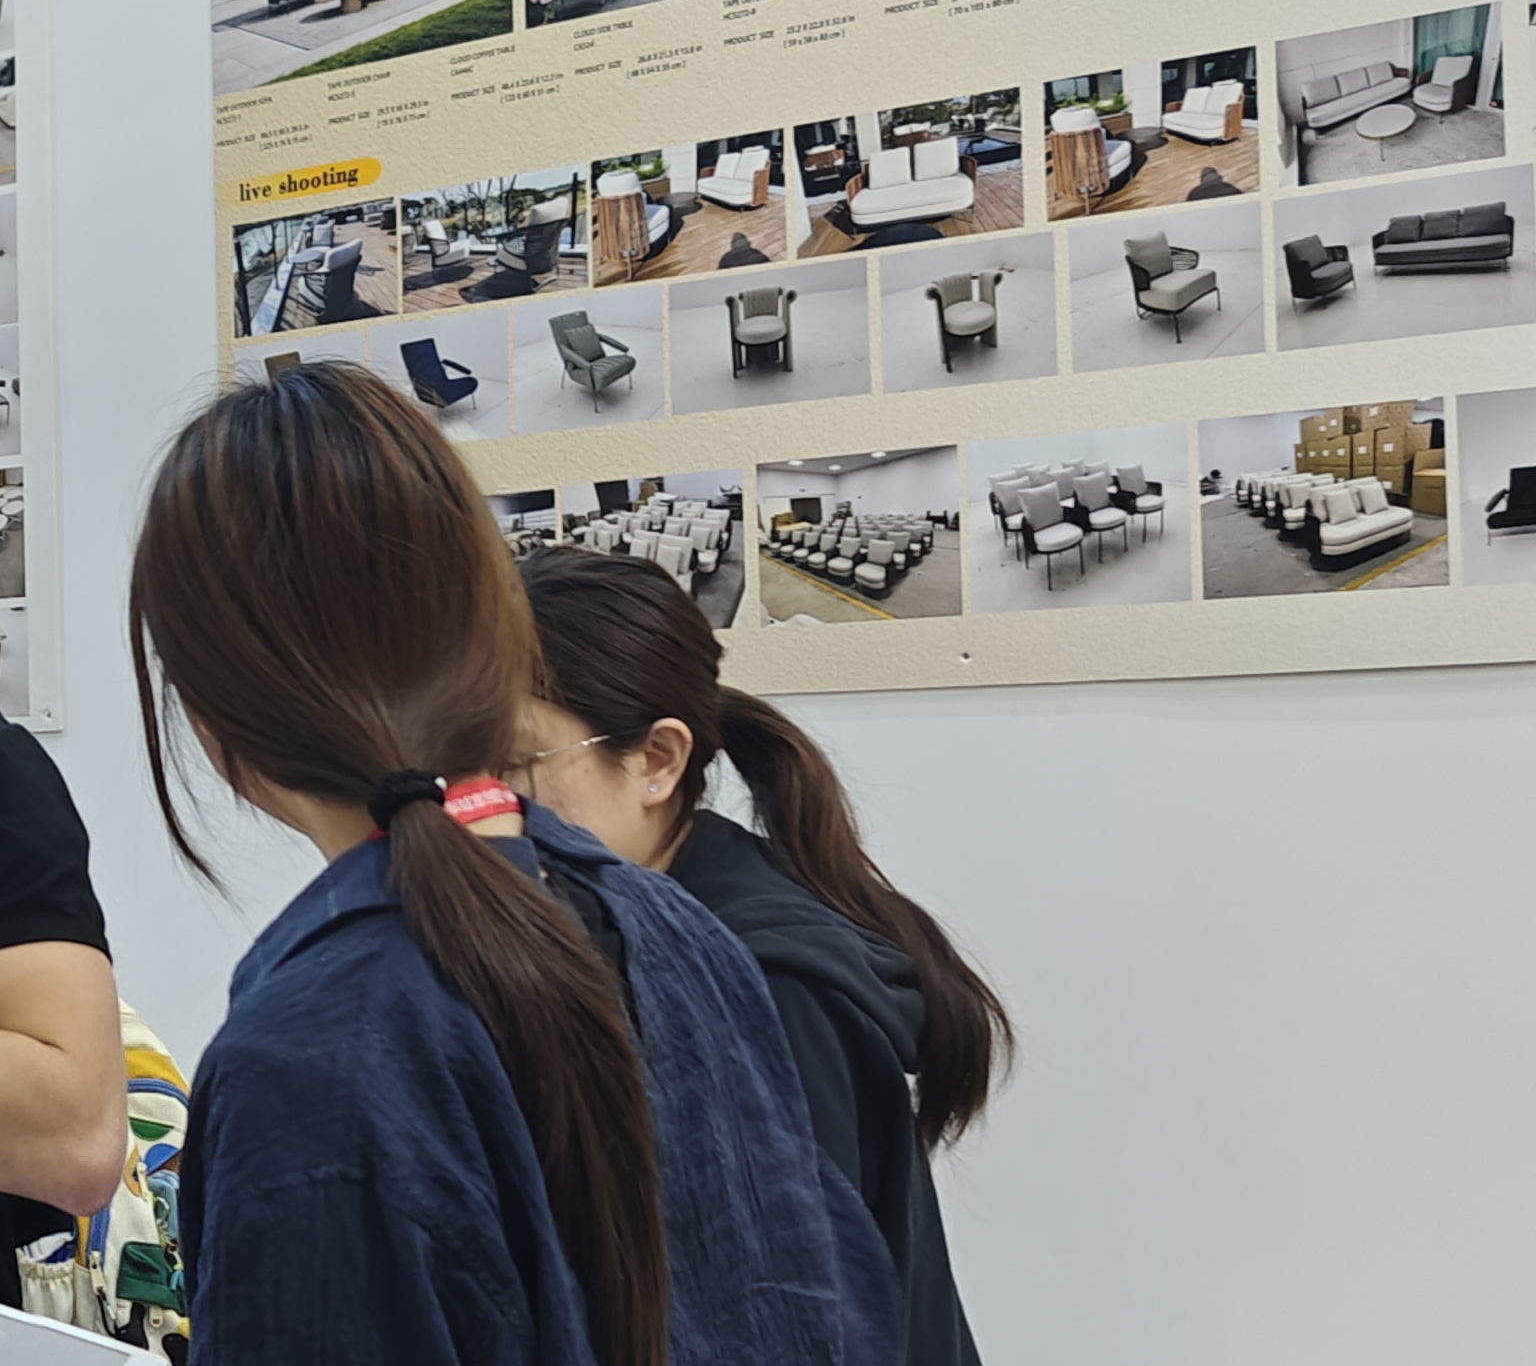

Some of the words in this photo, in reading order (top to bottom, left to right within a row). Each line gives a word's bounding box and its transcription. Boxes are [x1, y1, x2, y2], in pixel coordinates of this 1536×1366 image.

[884, 1, 920, 15] PRODUCT
[723, 33, 757, 47] PRODUCT
[759, 30, 775, 41] SIZE
[239, 182, 272, 202] live
[278, 166, 359, 195] shooting
